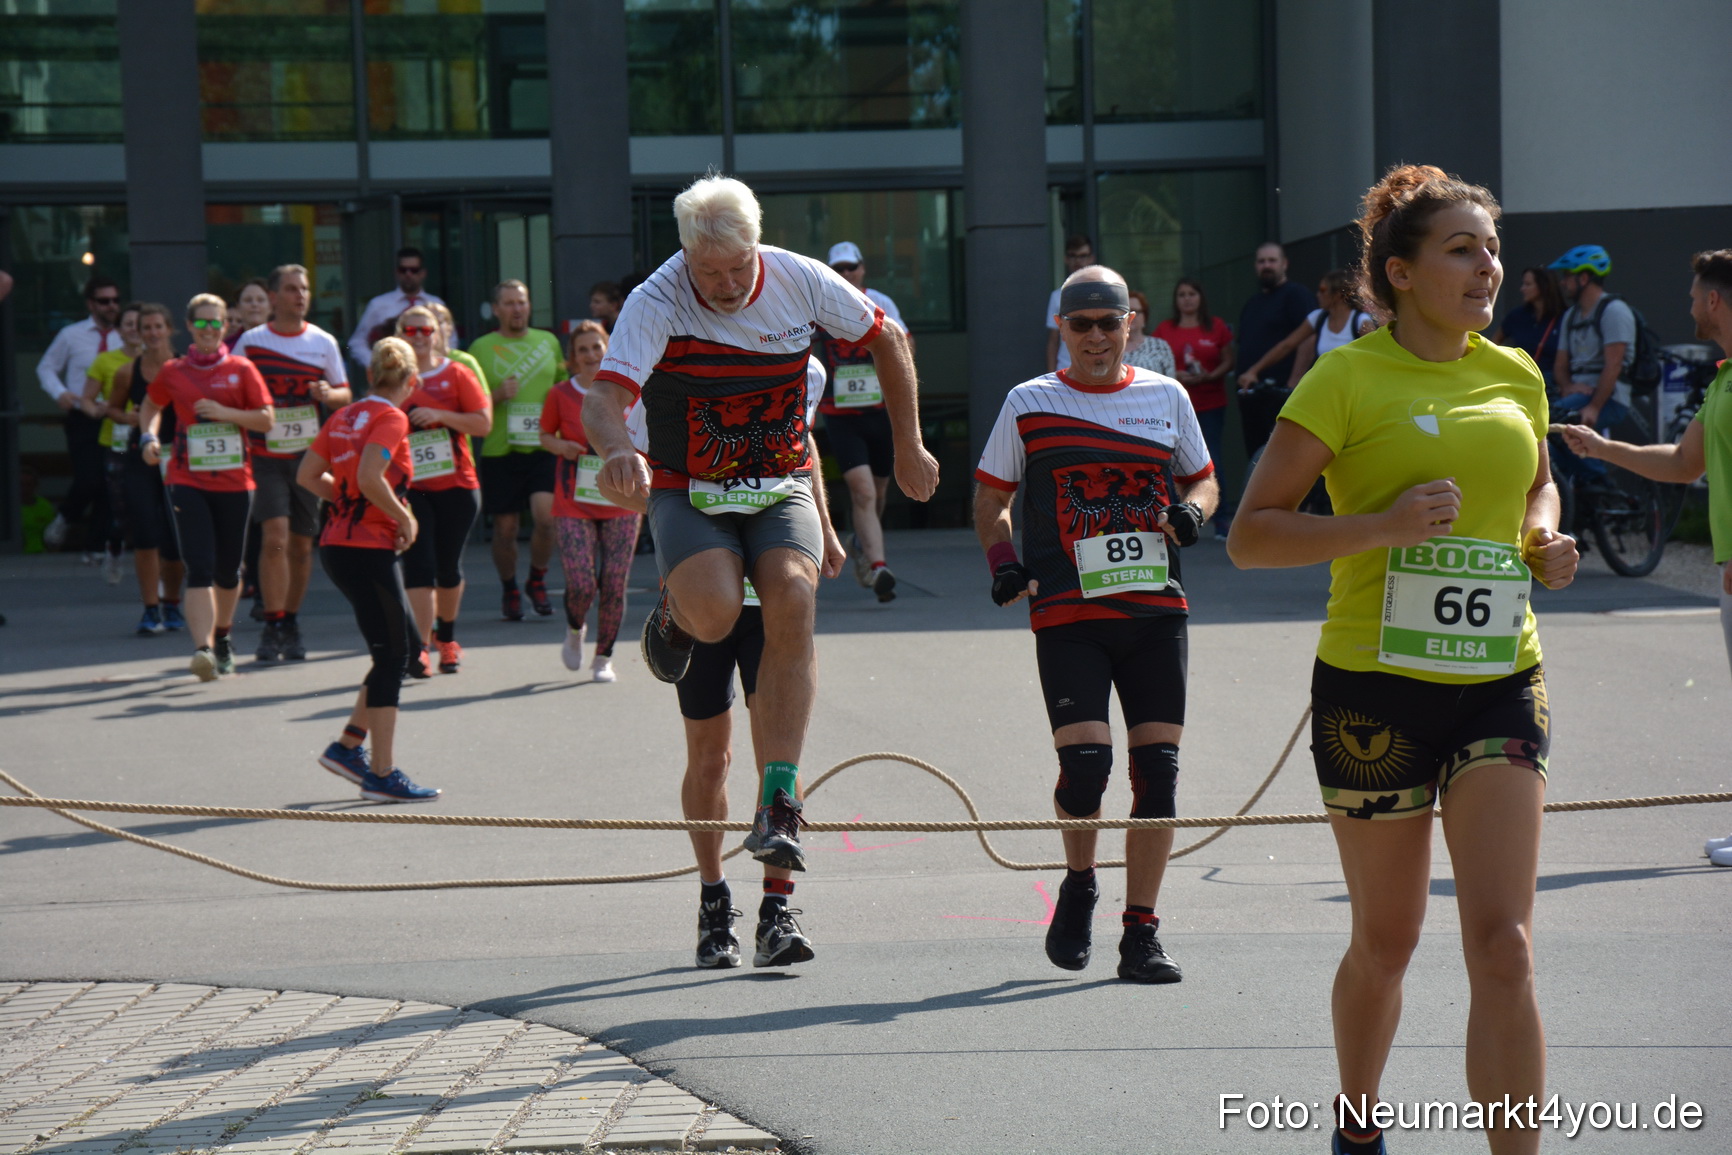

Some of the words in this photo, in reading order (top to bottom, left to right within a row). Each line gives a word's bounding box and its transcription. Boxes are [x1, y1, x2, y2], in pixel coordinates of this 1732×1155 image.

[759, 324, 809, 344] NEUMARKT
[847, 380, 866, 392] 82
[283, 423, 303, 437] 79
[1118, 417, 1165, 427] NEUMARKT
[205, 439, 226, 454] 53
[414, 446, 436, 463] 56
[706, 493, 778, 506] STEPHAN
[1106, 536, 1144, 562] 89
[1400, 542, 1522, 576] BOCK
[1101, 569, 1154, 585] STEFAN
[1434, 586, 1492, 628] 66
[1426, 638, 1488, 659] ELISA
